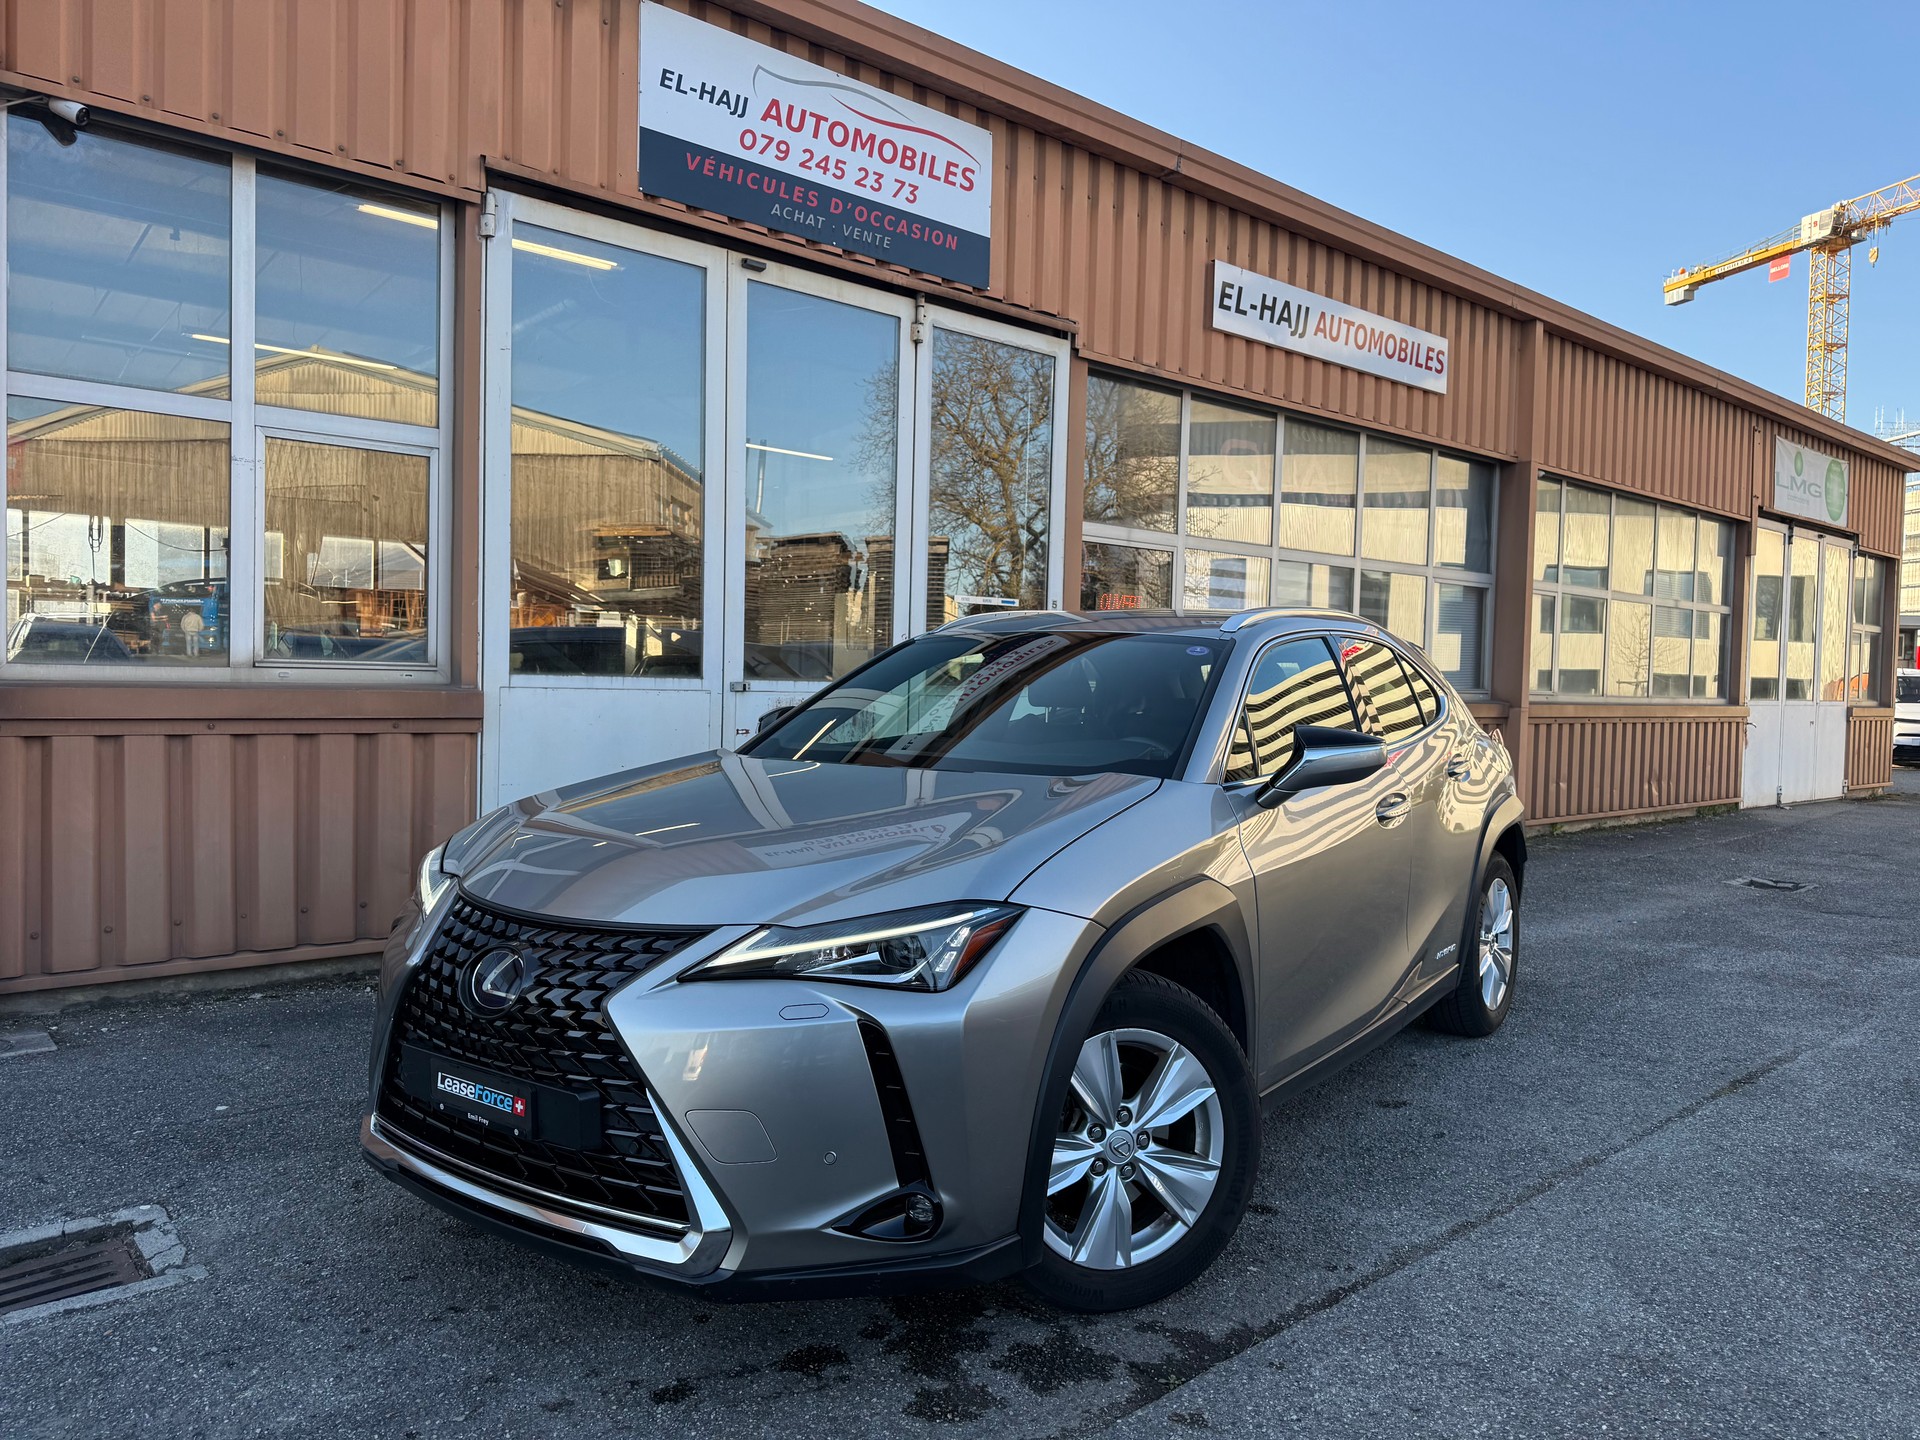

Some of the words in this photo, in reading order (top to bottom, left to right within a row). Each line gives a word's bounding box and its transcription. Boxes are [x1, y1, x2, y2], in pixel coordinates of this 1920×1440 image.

[659, 68, 749, 119] EL-HAJJ
[739, 128, 791, 162] 079
[798, 149, 847, 181] 245
[854, 167, 883, 194] 23
[891, 178, 919, 204] 73
[760, 98, 976, 192] AUTOMOBILES
[685, 152, 819, 207] VÉHICULES
[829, 197, 958, 250] D'OCCASION
[771, 203, 826, 229] ACHAT
[842, 224, 891, 249] VENTE
[1218, 280, 1310, 339] EL-HAJJ
[1313, 311, 1445, 375] AUTOMOBILES
[1776, 471, 1822, 498] LMG
[437, 1071, 513, 1111] LeaseForce
